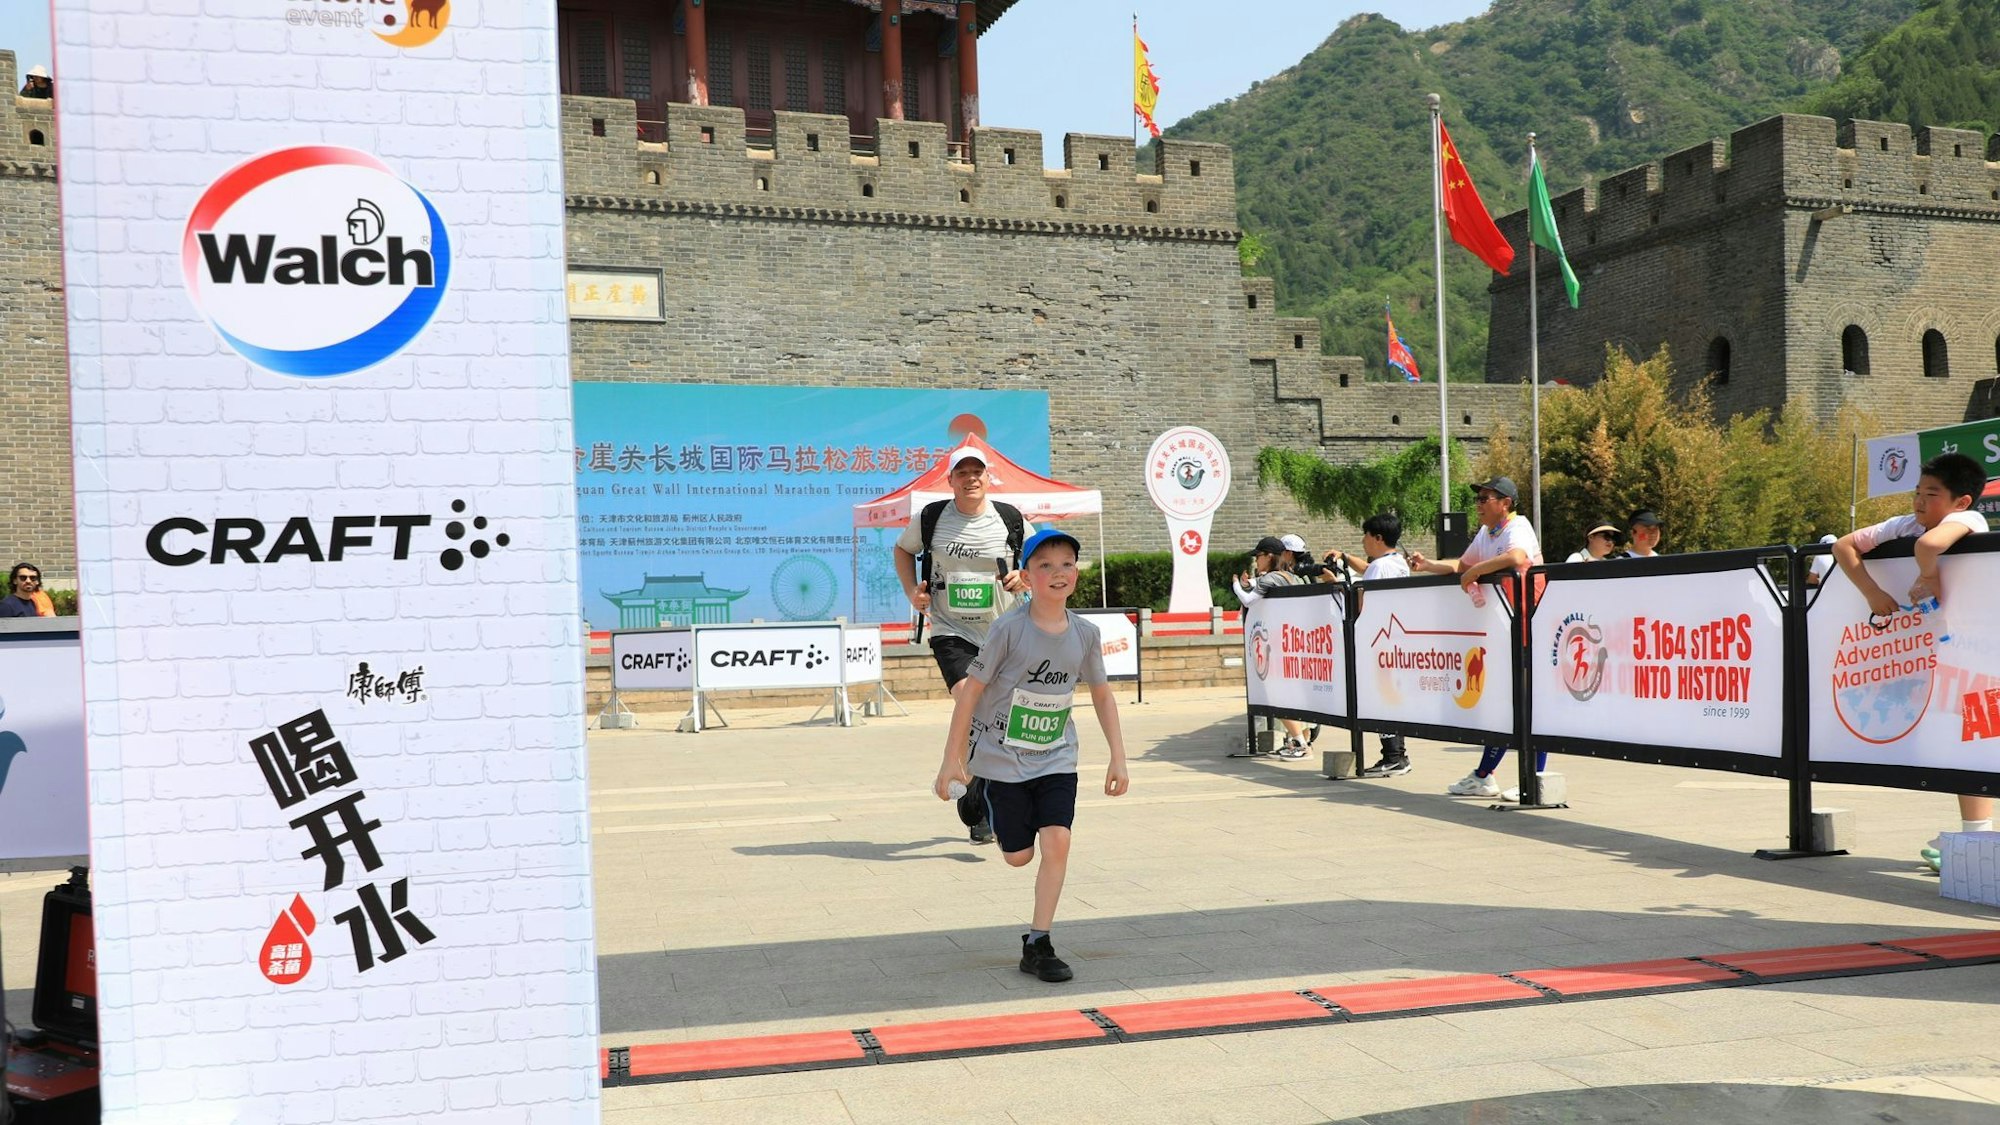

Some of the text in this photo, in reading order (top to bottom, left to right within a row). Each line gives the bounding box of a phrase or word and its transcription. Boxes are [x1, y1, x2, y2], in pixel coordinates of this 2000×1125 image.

[285, 8, 364, 28] event
[197, 233, 433, 285] Walch
[611, 484, 646, 495] Great
[653, 484, 680, 495] Wall
[687, 484, 767, 495] International
[774, 484, 830, 495] Marathon
[837, 484, 884, 494] Tourism
[146, 514, 432, 566] CRAFT
[955, 588, 983, 599] 1002
[1562, 612, 1585, 626] WALL
[1840, 611, 1922, 646] Albatros
[1282, 624, 1304, 653] 5.164
[1306, 624, 1333, 655] STEPS
[1633, 613, 1751, 661] 5.164 STEPS
[710, 649, 803, 667] CRAFT
[1378, 645, 1462, 671] culturestone
[1833, 631, 1934, 669] Adventure
[621, 653, 675, 670] CRAFT
[1283, 656, 1333, 682] INTO HISTORY
[1832, 653, 1938, 690] Marathons
[1027, 659, 1069, 686] Leon
[1419, 674, 1451, 691] event
[1634, 665, 1671, 699] INTO
[1678, 665, 1751, 703] HISTORY
[1703, 705, 1751, 719] since 1999
[1020, 714, 1060, 732] 1003
[1021, 732, 1037, 740] FUN
[270, 942, 303, 960] 高温
[267, 959, 301, 976] 杀菌
